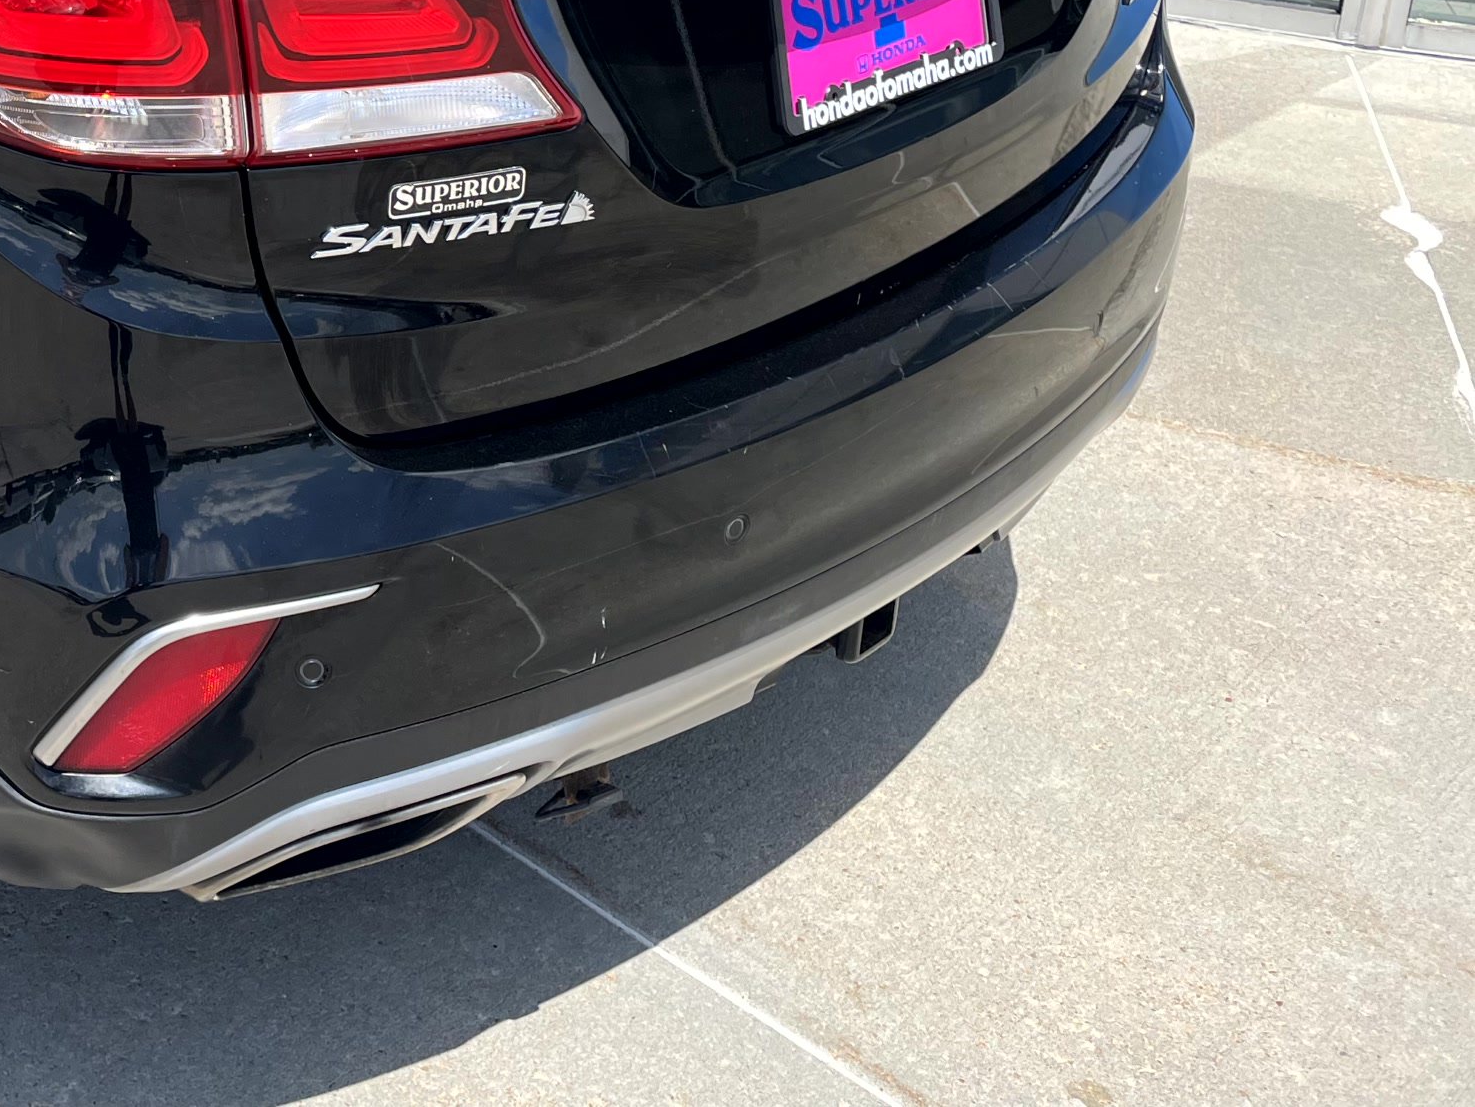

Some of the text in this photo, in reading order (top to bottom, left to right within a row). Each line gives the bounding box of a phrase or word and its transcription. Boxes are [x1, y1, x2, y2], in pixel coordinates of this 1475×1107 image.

[871, 35, 927, 64] HONDA
[800, 44, 995, 131] hondaofomaha.com
[393, 173, 521, 211] SUPERIOR
[431, 198, 483, 214] Omaha
